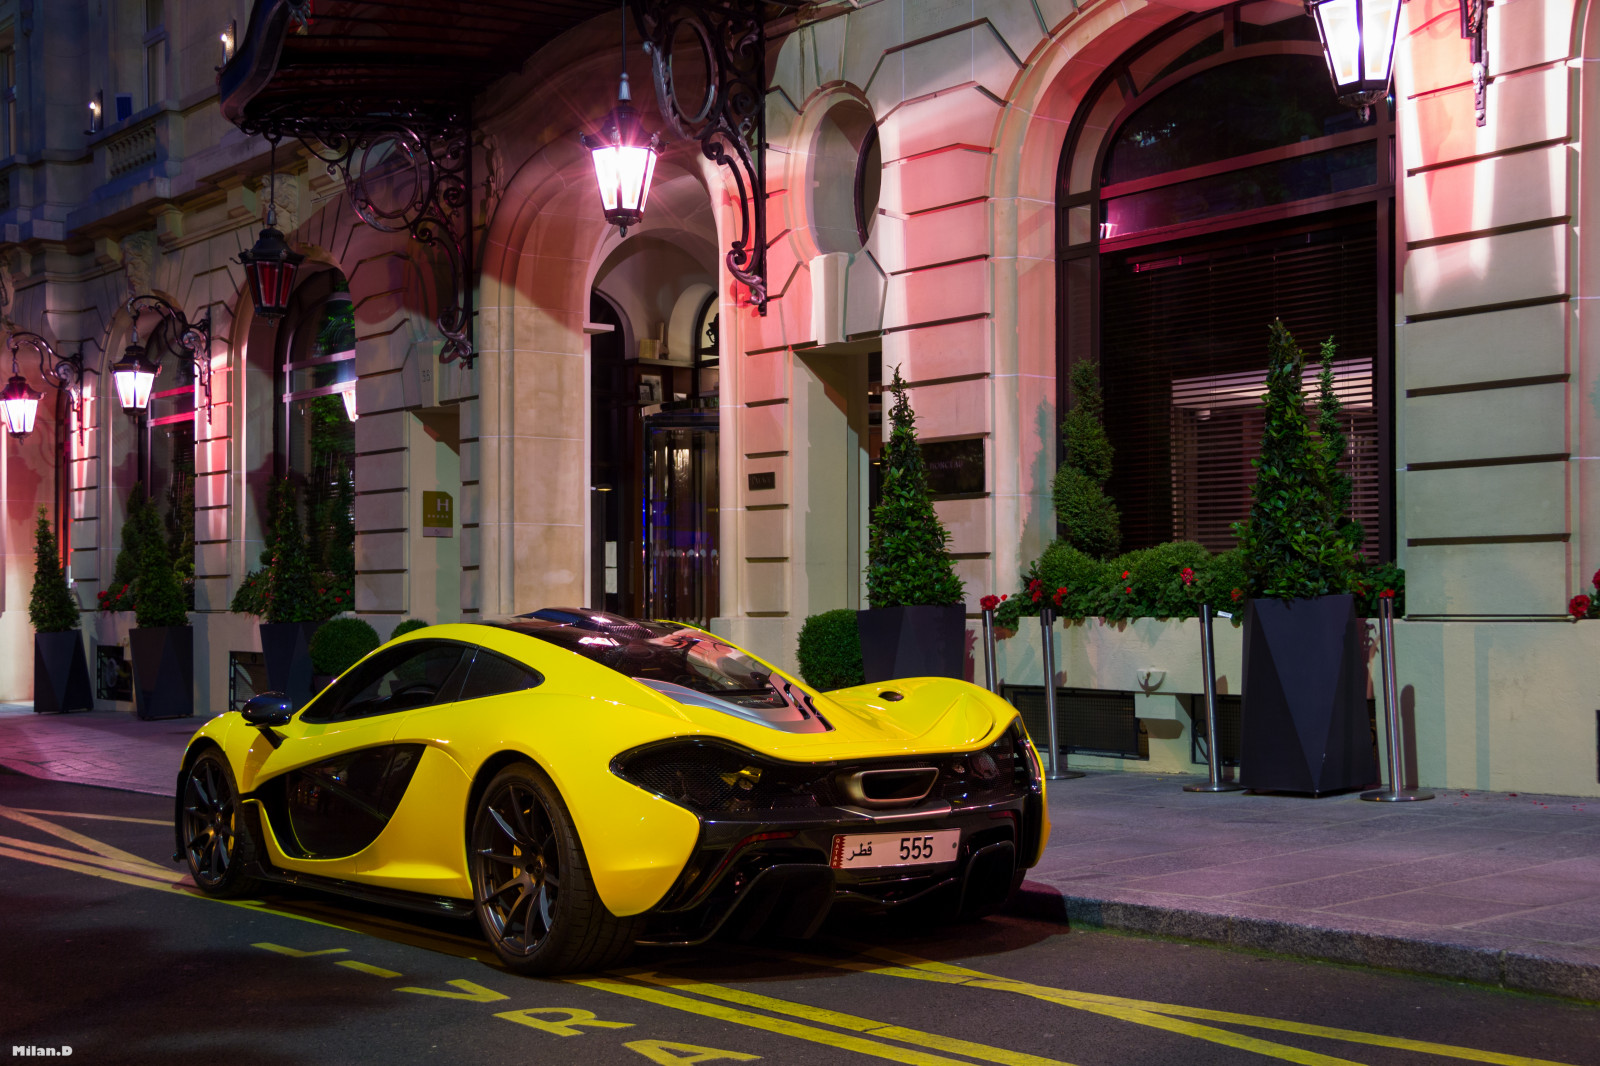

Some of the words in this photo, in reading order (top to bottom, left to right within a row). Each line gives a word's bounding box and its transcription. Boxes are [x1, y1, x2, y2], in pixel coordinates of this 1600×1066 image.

[436, 498, 449, 512] H
[832, 838, 841, 867] QATAR
[846, 841, 873, 861] قطر
[899, 837, 934, 861] 555
